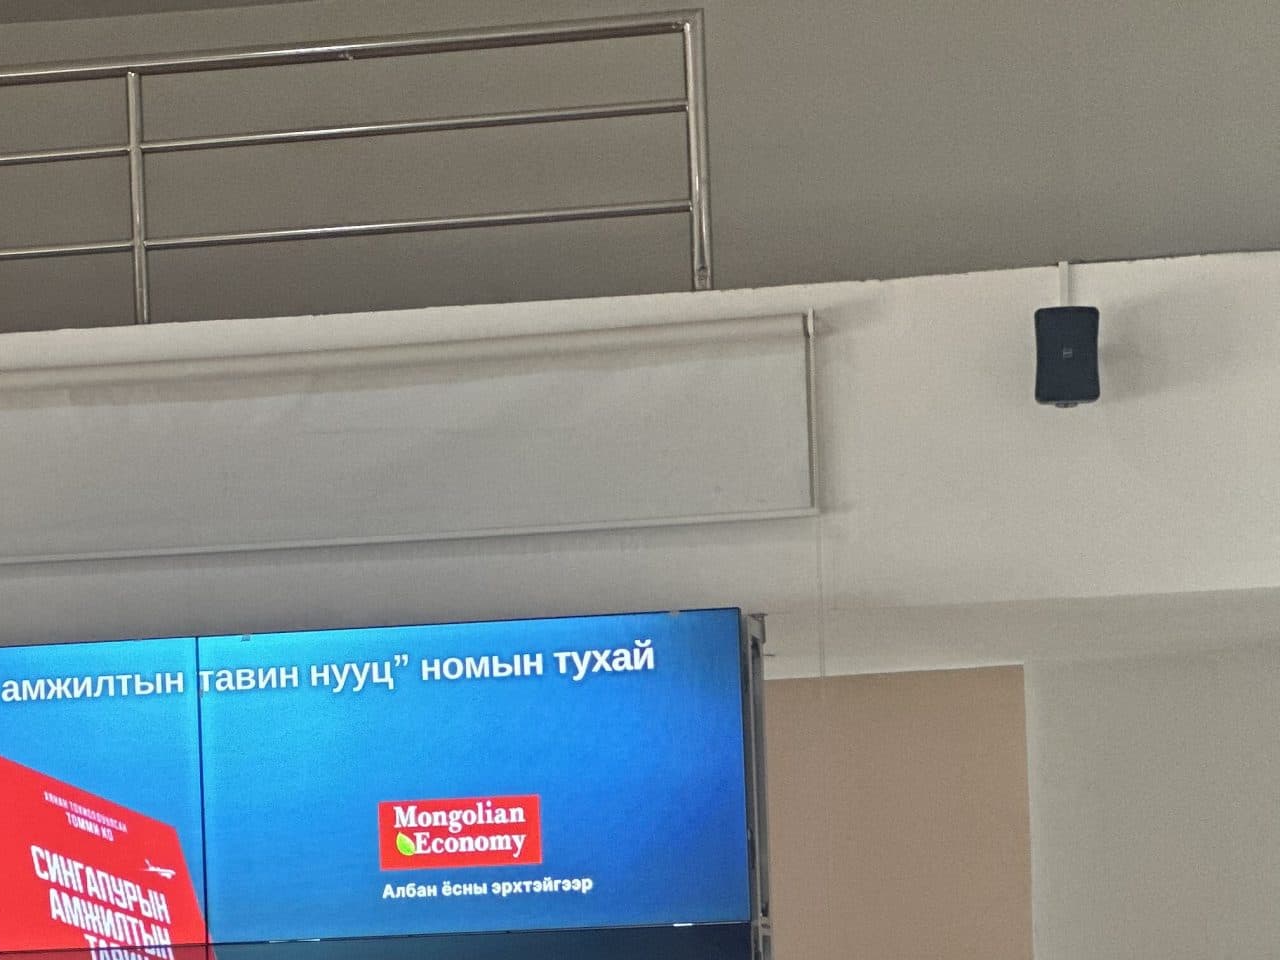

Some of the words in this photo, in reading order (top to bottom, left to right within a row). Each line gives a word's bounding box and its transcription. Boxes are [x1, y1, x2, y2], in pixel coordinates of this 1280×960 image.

[0, 670, 184, 705] амжилтын
[200, 665, 299, 693] тавин
[310, 654, 409, 695] нууц”
[421, 649, 544, 681] номын
[553, 639, 656, 681] тухай
[394, 801, 526, 833] Mongolian
[414, 831, 527, 858] Economy
[30, 844, 171, 924] СИНГАПУРЫН
[382, 880, 438, 900] Албан
[441, 879, 488, 898] ёсны
[491, 876, 593, 899] эрхтэйгээр
